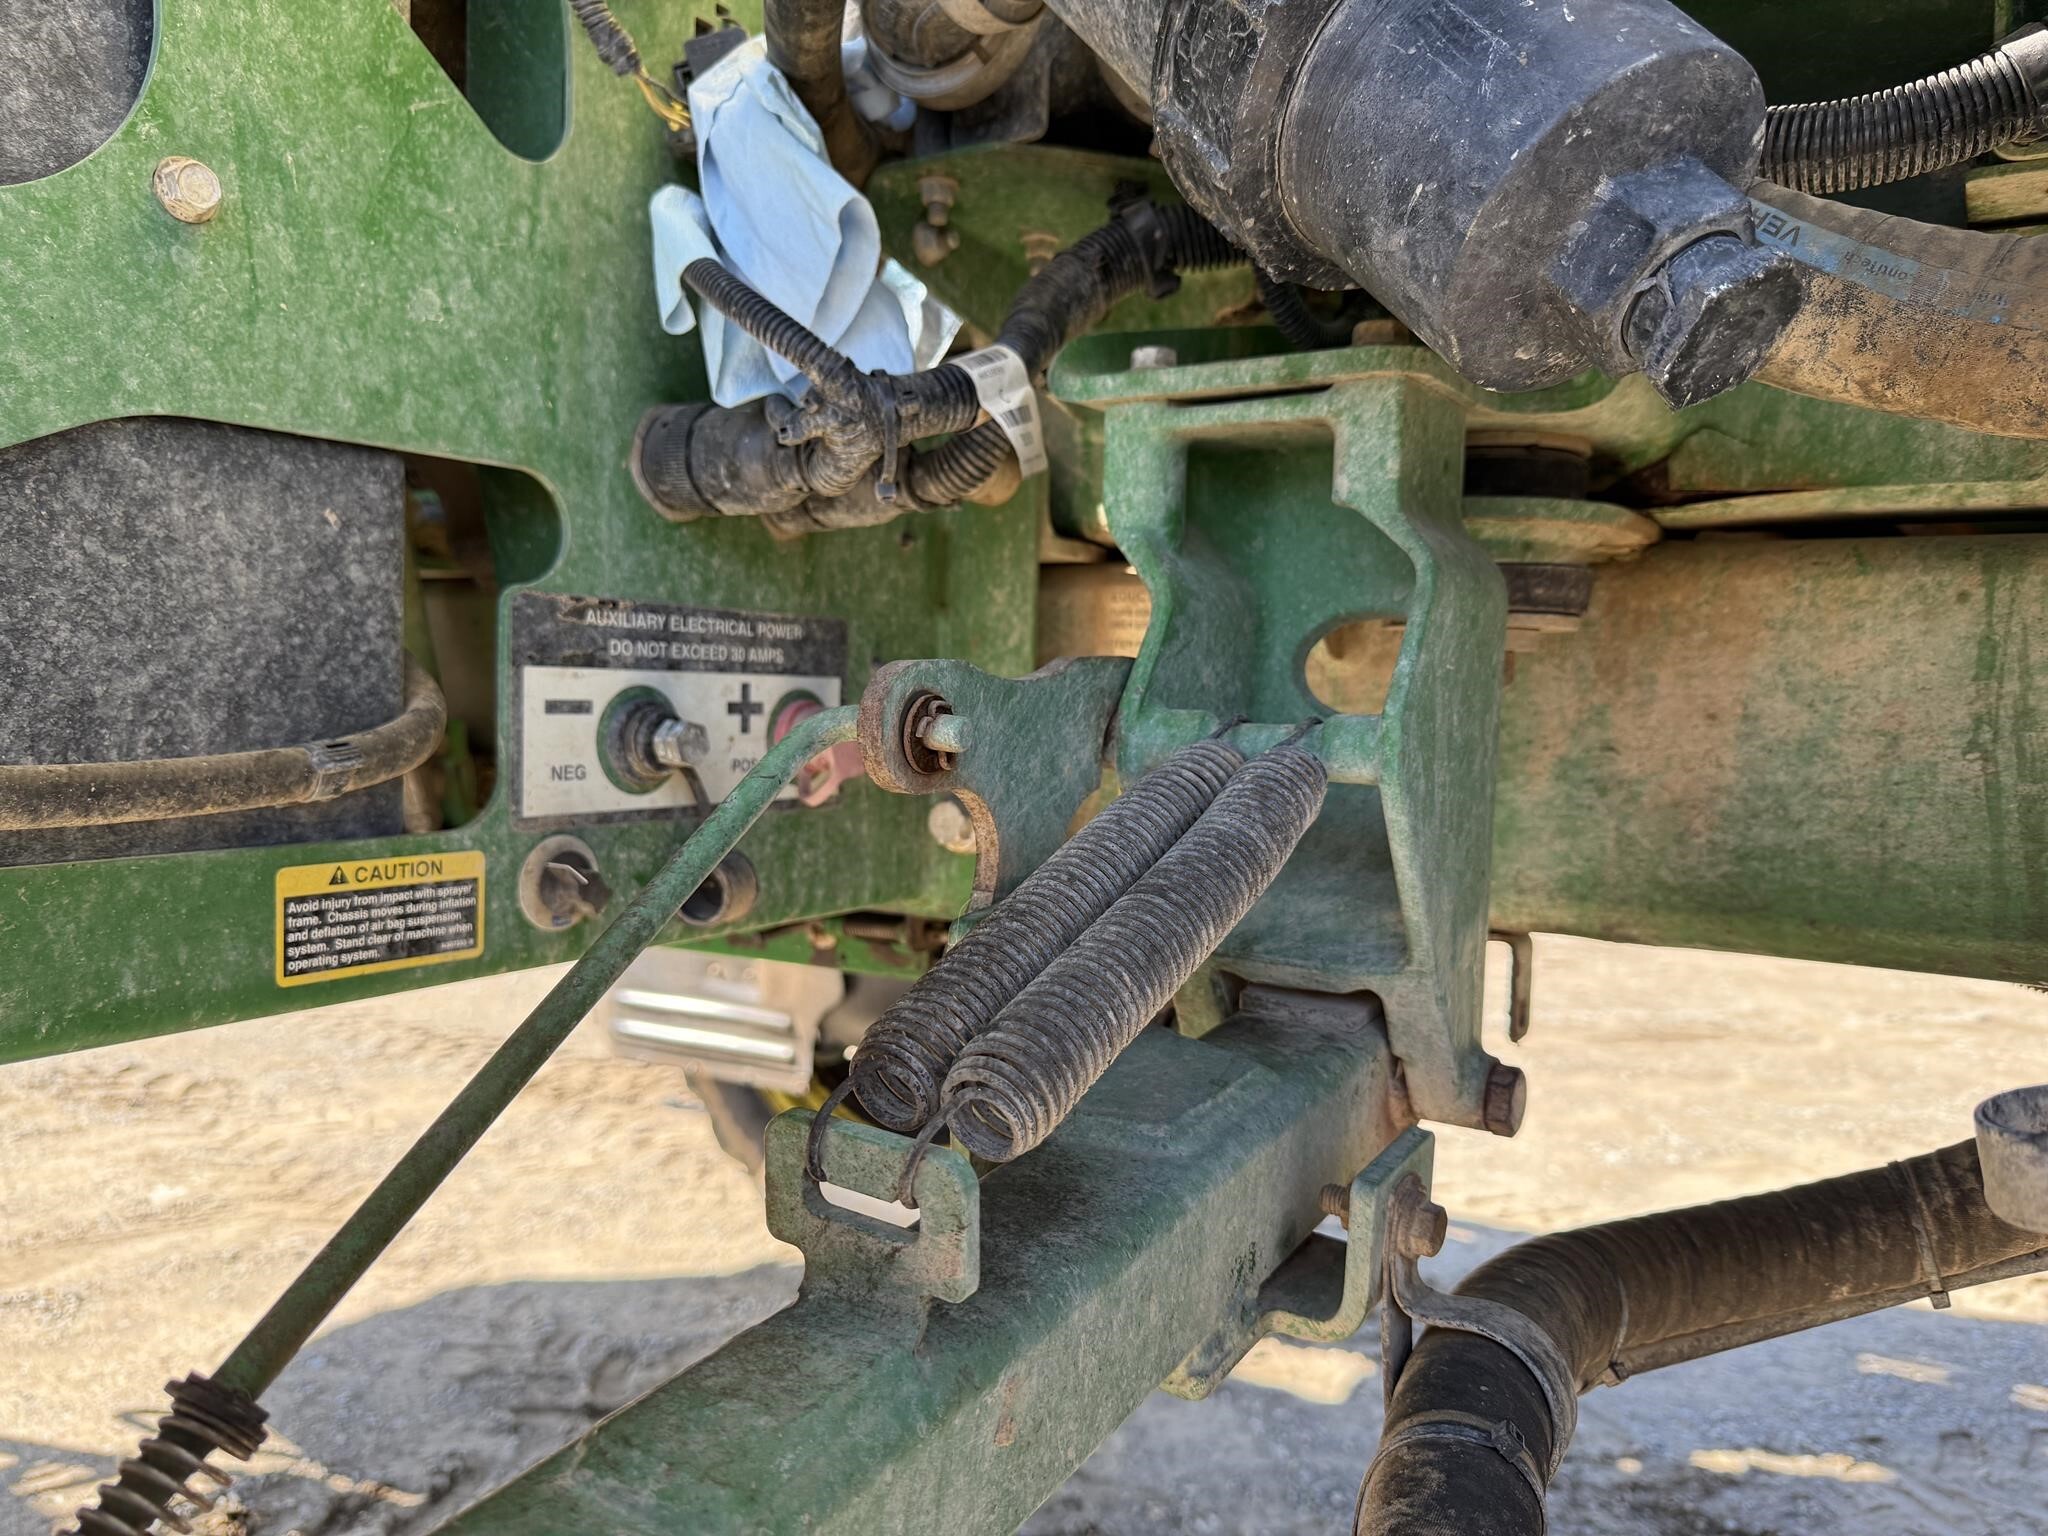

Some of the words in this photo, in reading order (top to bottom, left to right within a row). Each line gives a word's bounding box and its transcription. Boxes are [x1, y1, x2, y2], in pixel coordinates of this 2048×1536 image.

[1844, 250, 1914, 280] ontiTech
[586, 609, 666, 631] AUXILIARY
[670, 614, 755, 637] ELECTRICAL
[758, 621, 803, 640] POWER
[609, 637, 634, 657] DO
[636, 640, 669, 659] NOT
[672, 642, 728, 662] EXCEED
[730, 645, 746, 663] 30
[748, 647, 785, 664] AMPS
[551, 764, 587, 782] NEG
[354, 860, 444, 883] CAUTION
[287, 899, 320, 914] Avoid
[321, 897, 352, 911] injury
[353, 894, 378, 907] from
[380, 890, 413, 904] impact
[415, 887, 436, 899] with
[438, 884, 473, 898] sprayer
[287, 915, 323, 930] frame.
[327, 908, 369, 924] Chassis
[371, 905, 404, 918] moves
[405, 900, 438, 914] during
[440, 896, 477, 910] inflation
[287, 929, 309, 943] and
[310, 923, 357, 940] deflation
[358, 921, 370, 934] of
[370, 919, 386, 931] air
[387, 917, 406, 930] bag
[407, 910, 462, 926] suspension
[287, 942, 331, 958] system.
[335, 935, 366, 951] Stand
[367, 932, 392, 945] clear
[394, 930, 405, 941] of
[406, 924, 447, 940] machine
[448, 921, 473, 934] when
[287, 953, 340, 972] operating
[340, 947, 382, 964] system.
